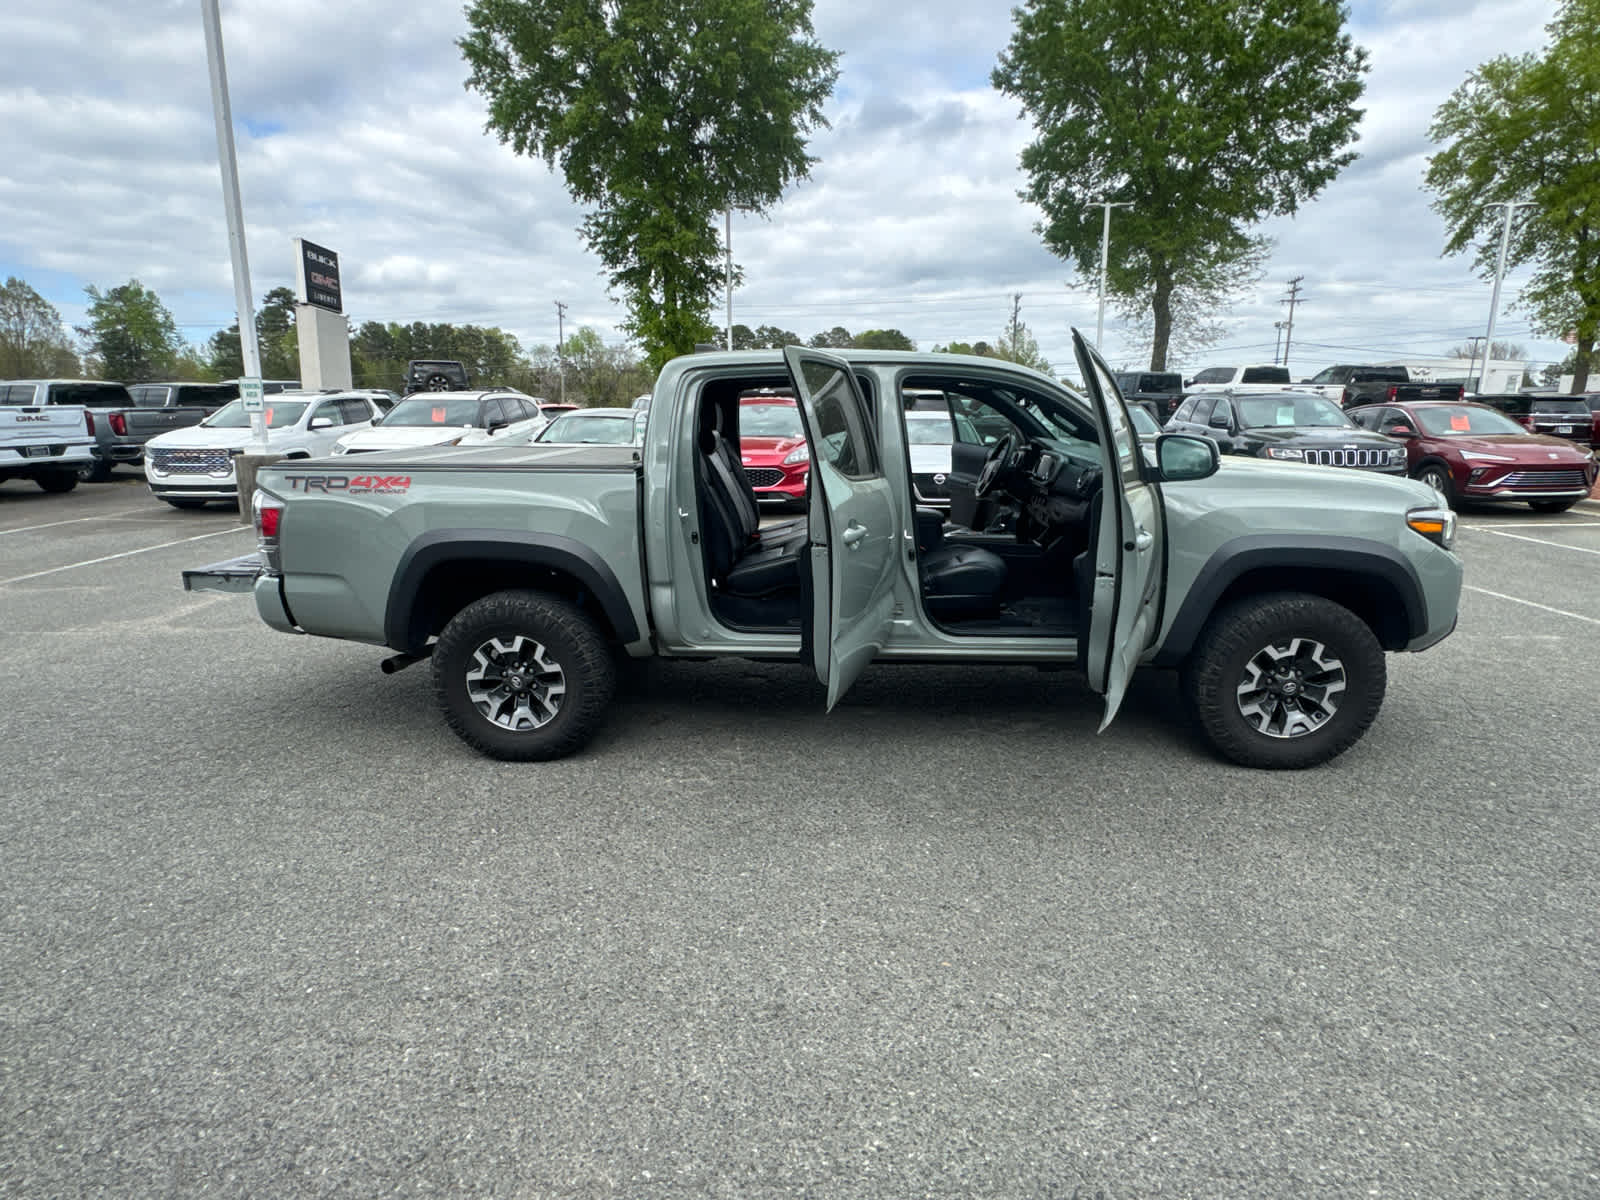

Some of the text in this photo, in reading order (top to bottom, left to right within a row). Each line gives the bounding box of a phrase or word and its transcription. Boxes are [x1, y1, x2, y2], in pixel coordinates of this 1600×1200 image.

[306, 250, 337, 268] BUICK
[310, 271, 339, 290] GMC
[284, 475, 350, 494] TRD
